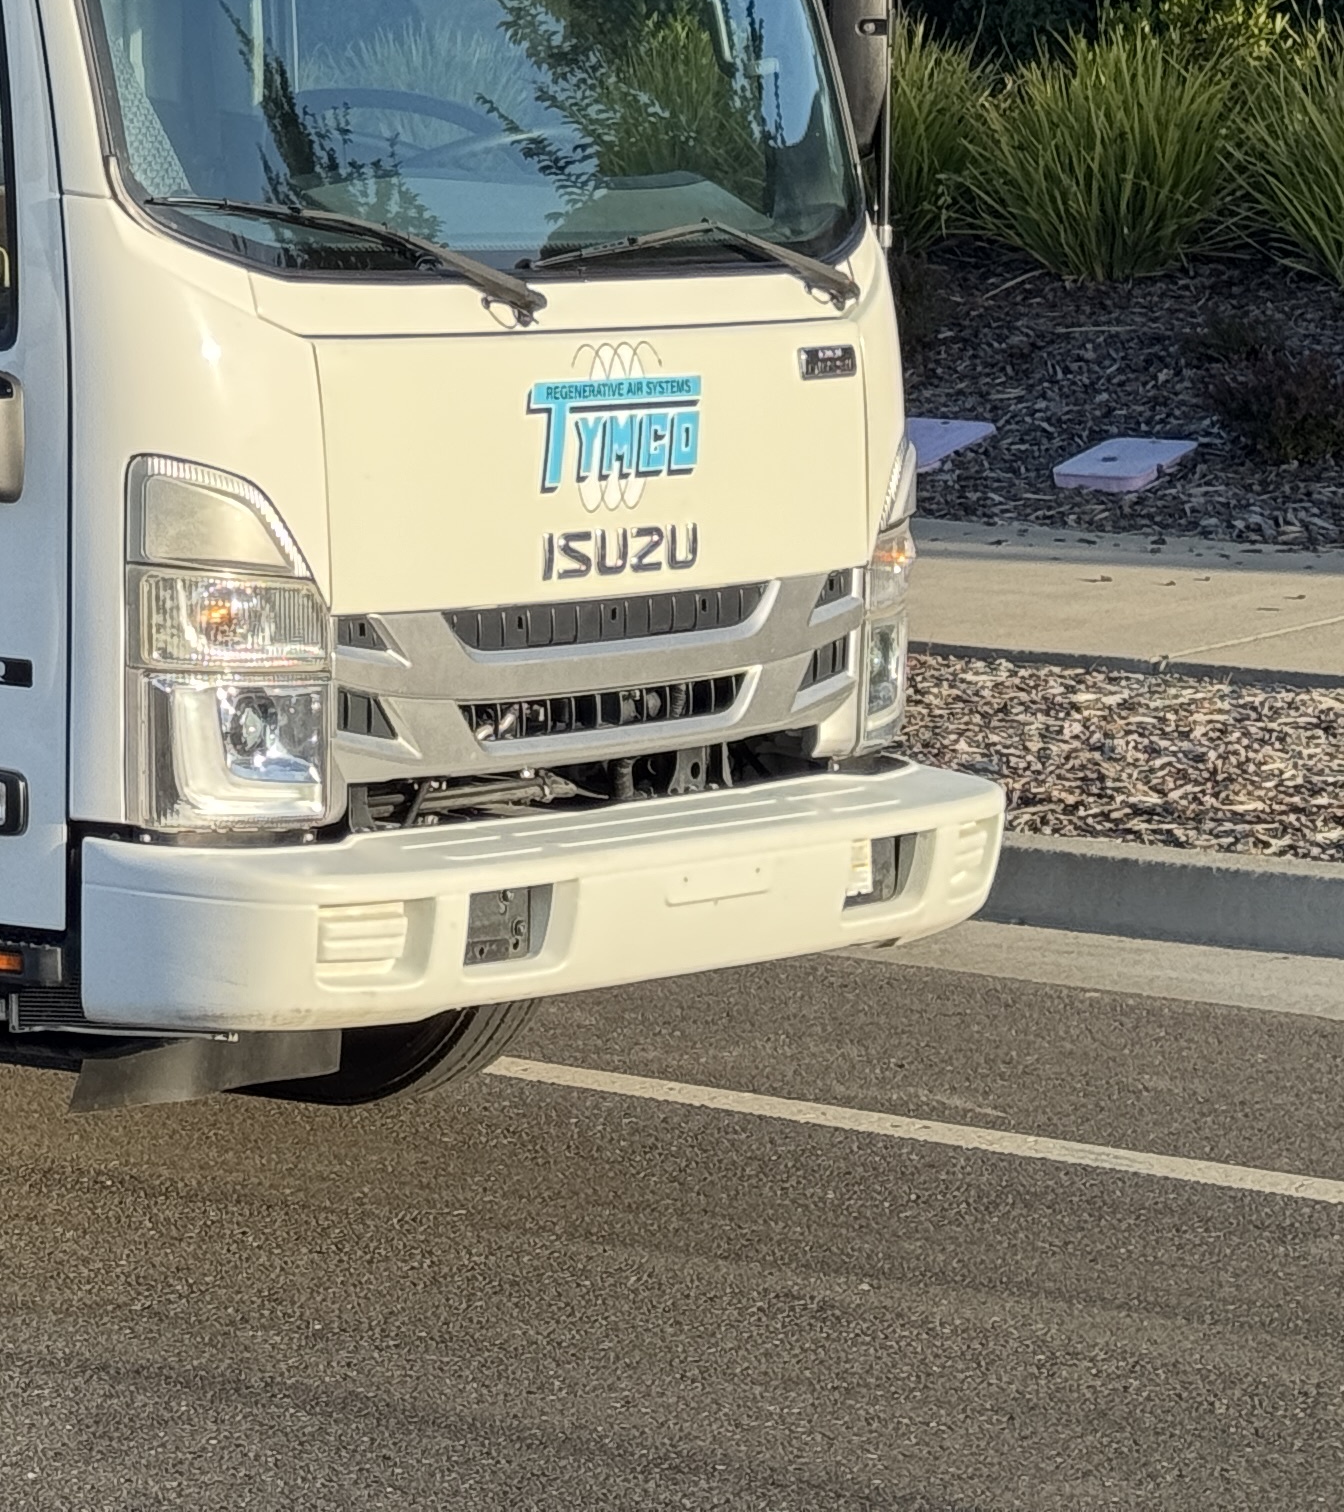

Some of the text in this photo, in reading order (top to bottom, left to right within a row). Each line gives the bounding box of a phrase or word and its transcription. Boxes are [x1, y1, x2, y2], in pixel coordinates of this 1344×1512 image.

[545, 378, 692, 400] REGENERATIVE AIR SYSTEMS
[526, 375, 702, 494] TYMCO
[541, 521, 699, 582] ISUZU
